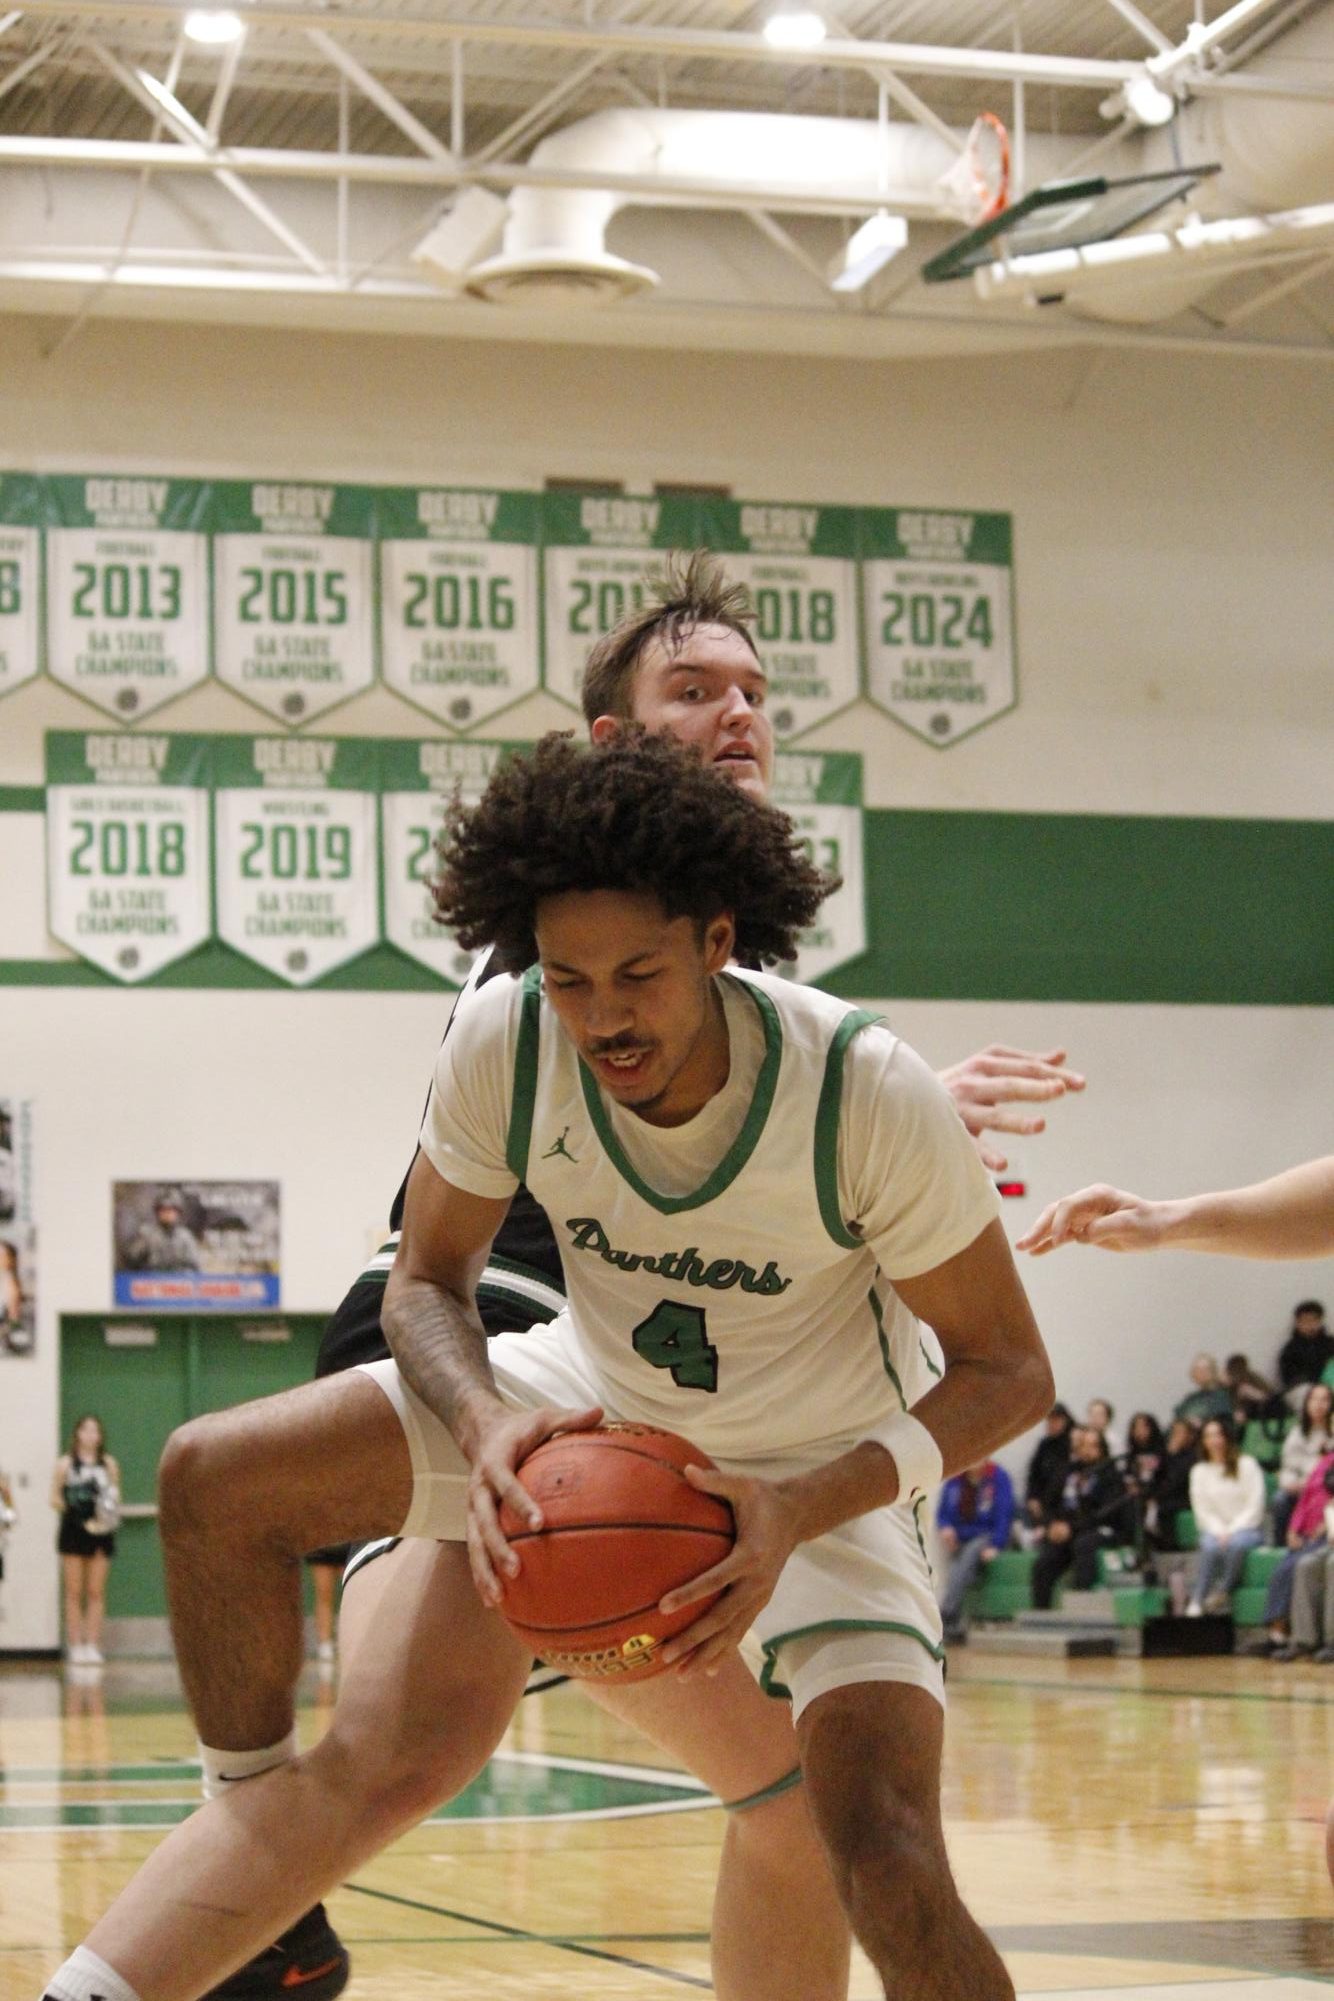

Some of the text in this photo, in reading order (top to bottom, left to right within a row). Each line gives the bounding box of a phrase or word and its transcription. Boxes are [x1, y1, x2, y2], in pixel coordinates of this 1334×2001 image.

[72, 563, 181, 620] 2013
[239, 567, 347, 625] 2015
[403, 572, 514, 630] 2016
[882, 591, 993, 648] 2024
[117, 632, 164, 652] STATE
[283, 637, 329, 657] STATE
[448, 641, 496, 662] STATE
[75, 654, 177, 677] CHAMPIONS
[242, 658, 343, 682] CHAMPIONS
[411, 662, 510, 687] CHAMPIONS
[929, 658, 974, 679] STATE
[891, 680, 986, 704] CHAMPIONS
[69, 821, 185, 876] 2018
[240, 822, 351, 880] 2019
[117, 888, 165, 910] STATE
[286, 891, 334, 913] STATE
[76, 912, 179, 935] CHAMPIONS
[244, 914, 348, 938] CHAMPIONS
[566, 1217, 792, 1296] Panthers
[632, 1298, 718, 1393] 4
